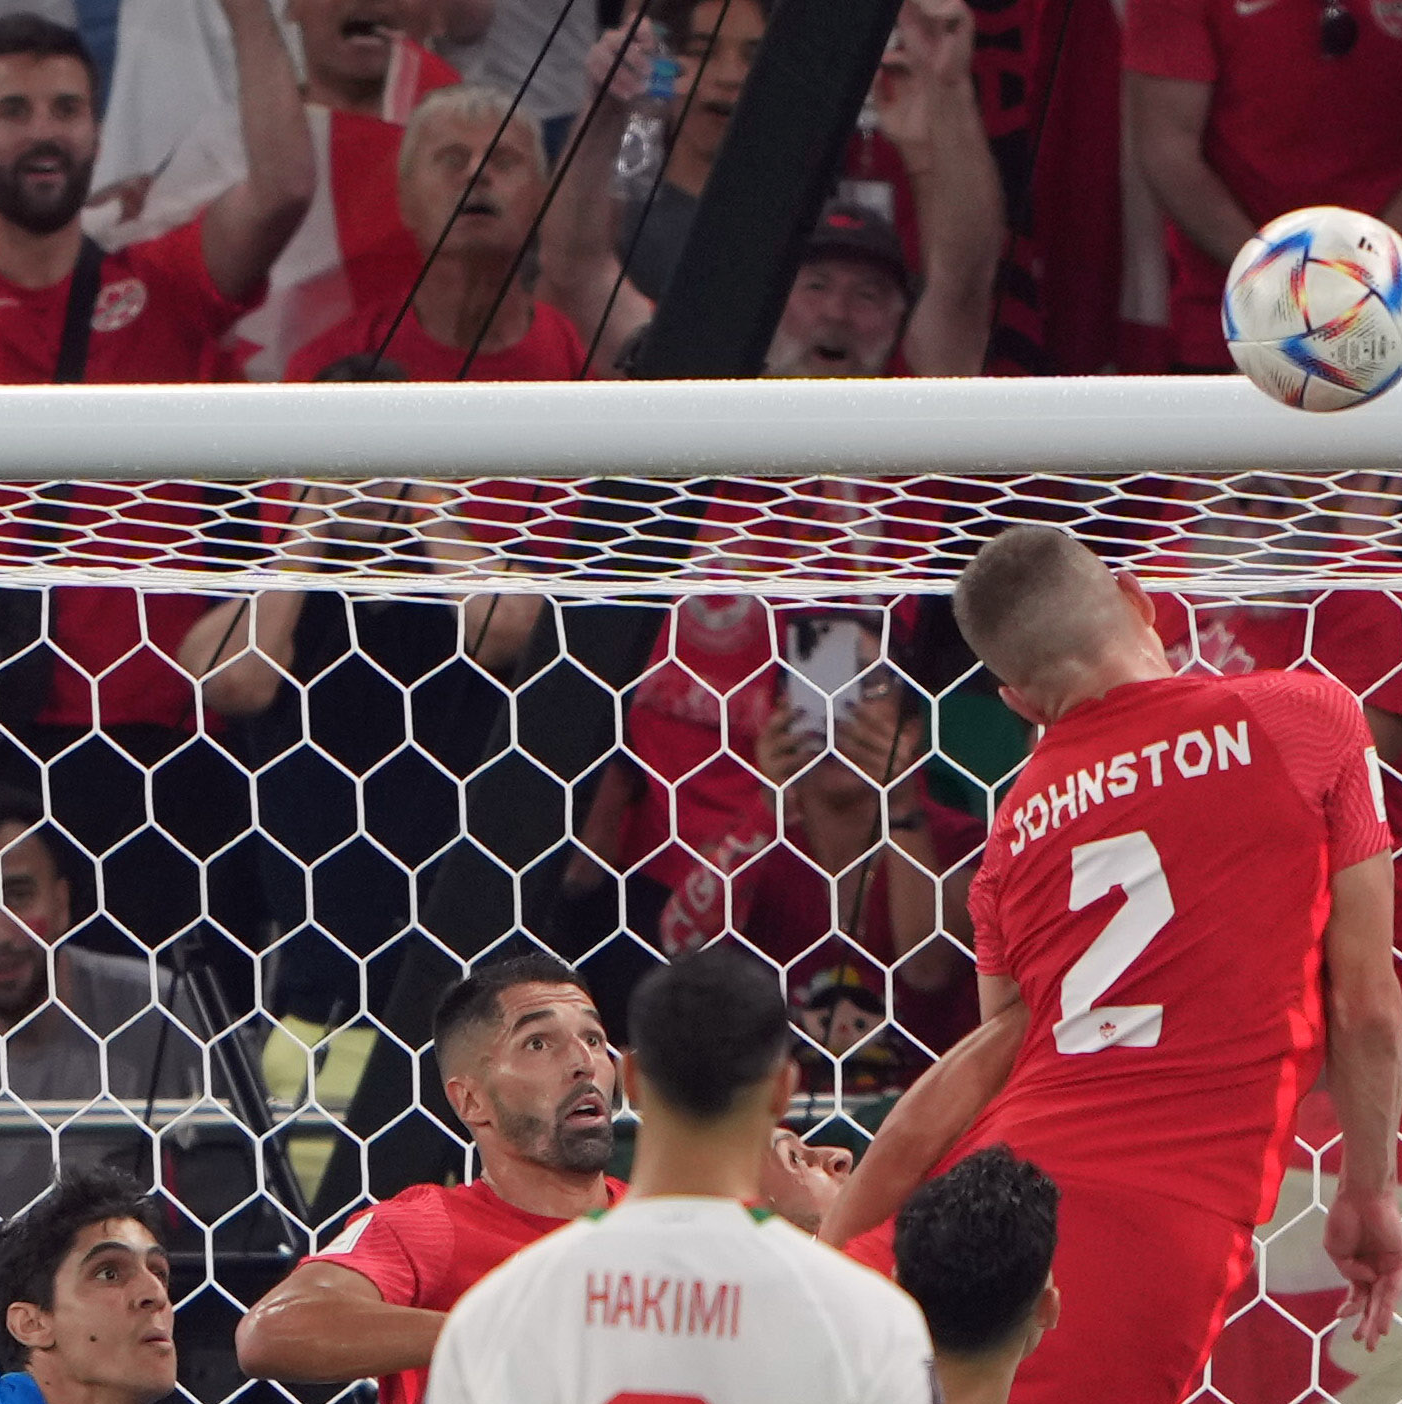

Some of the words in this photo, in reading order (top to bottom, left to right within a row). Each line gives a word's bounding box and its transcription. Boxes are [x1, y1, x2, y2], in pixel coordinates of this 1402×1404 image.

[1009, 718, 1253, 857] JOHNSTON
[1052, 829, 1176, 1057] 2
[585, 1272, 743, 1339] HAKIMI
